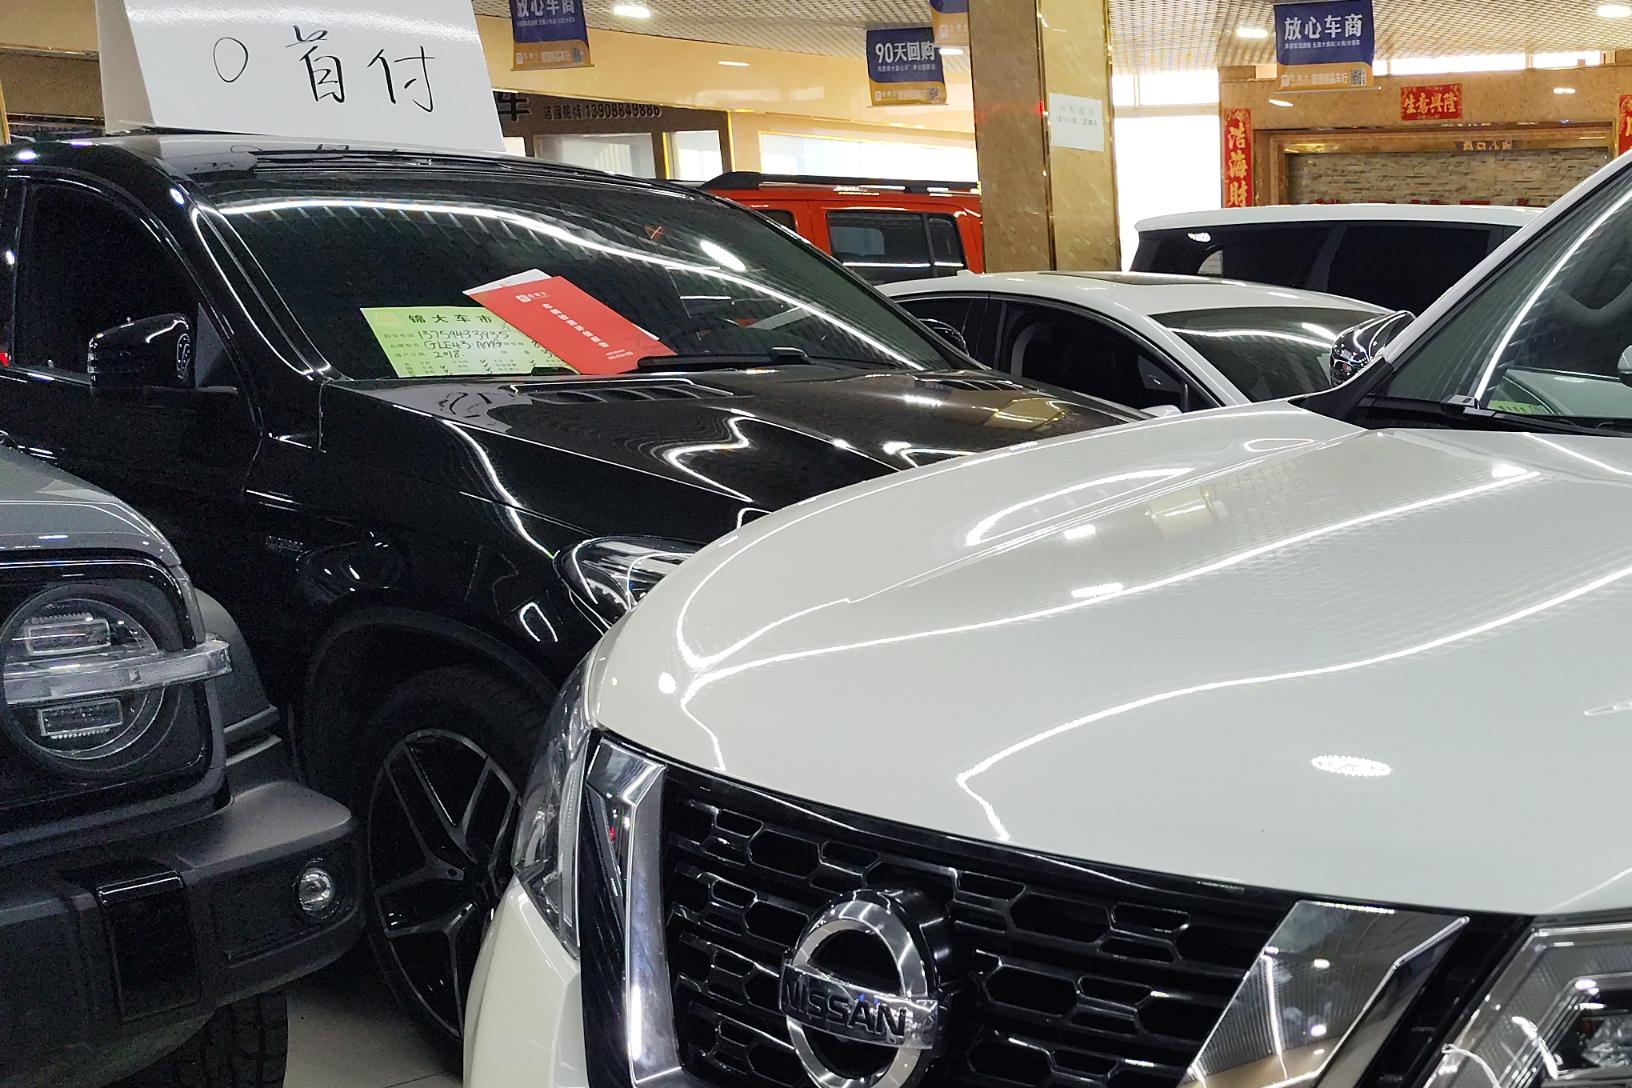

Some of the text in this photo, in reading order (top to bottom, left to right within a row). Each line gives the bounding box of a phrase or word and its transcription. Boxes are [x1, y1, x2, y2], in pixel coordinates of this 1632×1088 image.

[1283, 13, 1364, 40] 放心车商
[875, 41, 936, 63] 90天回购
[408, 313, 493, 324] 锦大车市
[783, 966, 907, 1044] NISSAN
